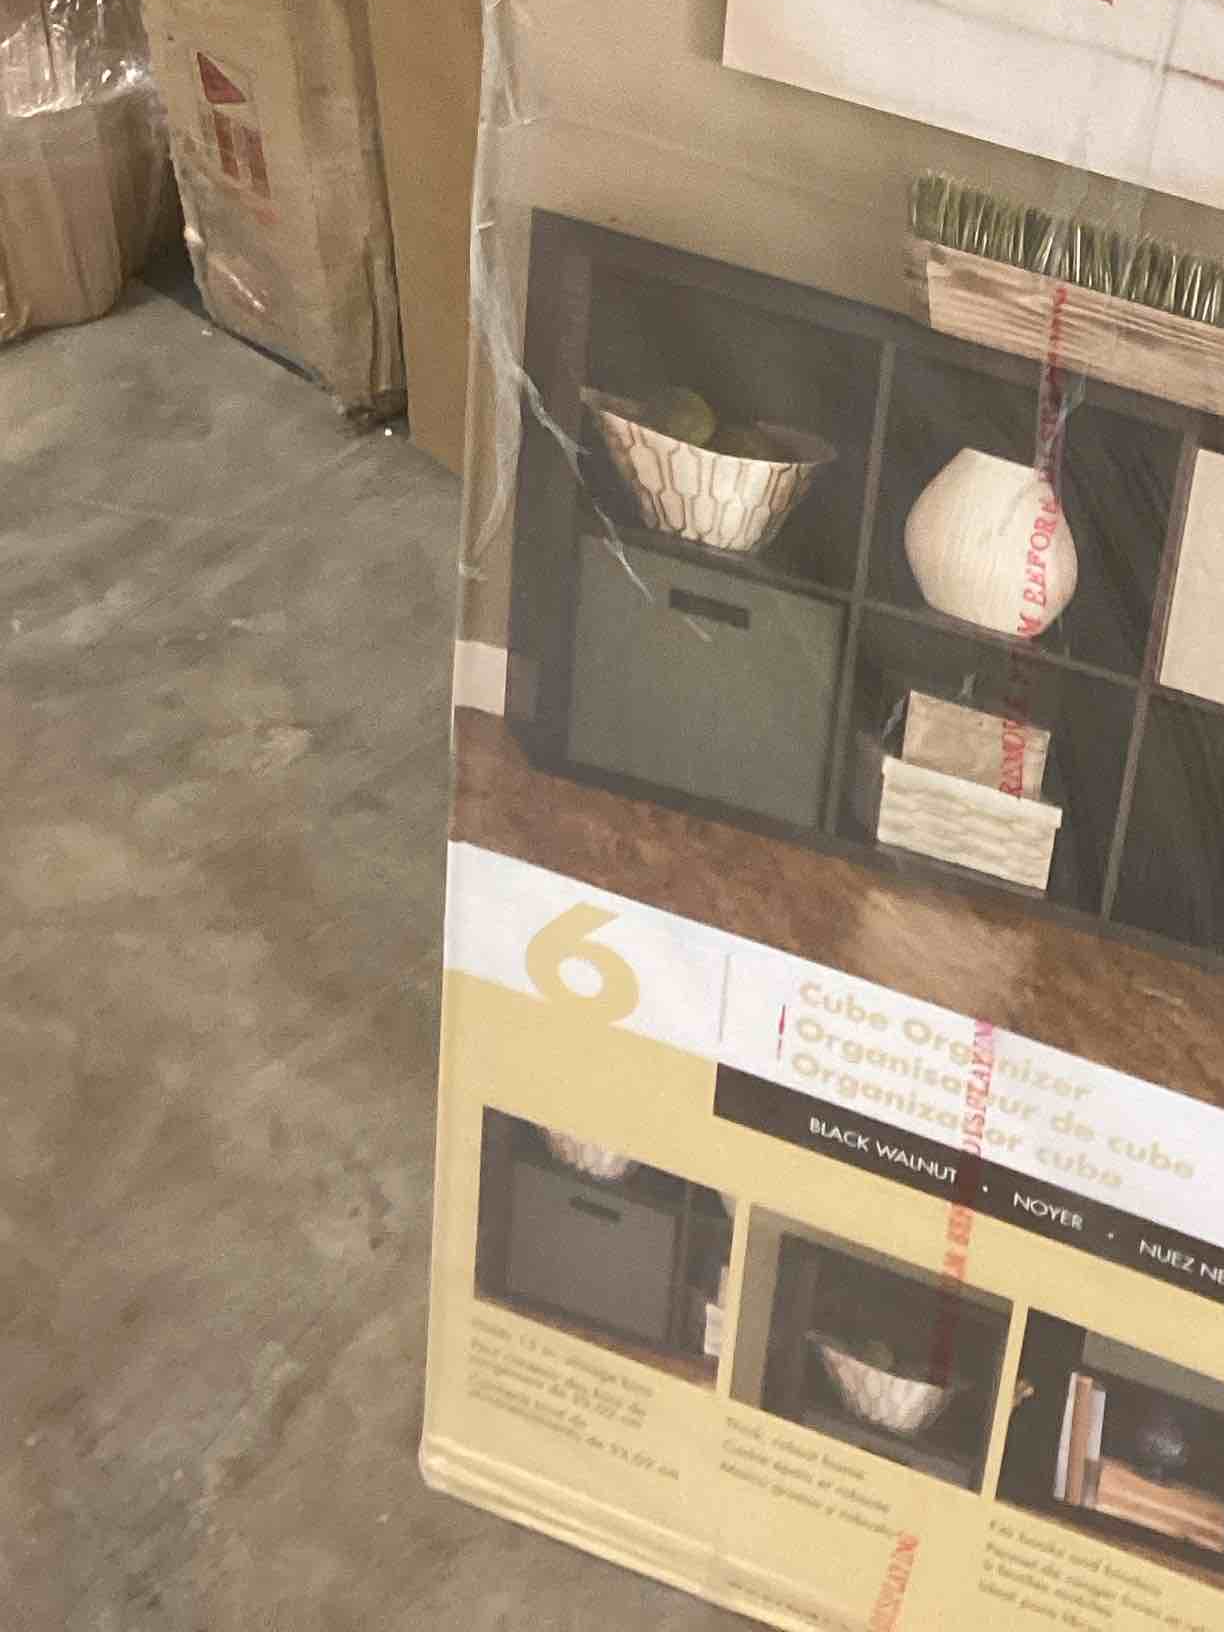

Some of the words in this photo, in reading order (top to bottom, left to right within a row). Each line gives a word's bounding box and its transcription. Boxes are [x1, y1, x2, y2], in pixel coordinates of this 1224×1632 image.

[523, 901, 641, 1029] 6
[800, 980, 889, 1032] Cube
[791, 1052, 1024, 1151] Organizaor
[796, 1016, 1036, 1119] Organisaur
[1051, 1110, 1097, 1142] de
[808, 1115, 869, 1153] BLACK
[874, 1140, 958, 1185] WALNUT
[1012, 1190, 1085, 1231] NOYER
[1138, 1239, 1195, 1273] NUEZ
